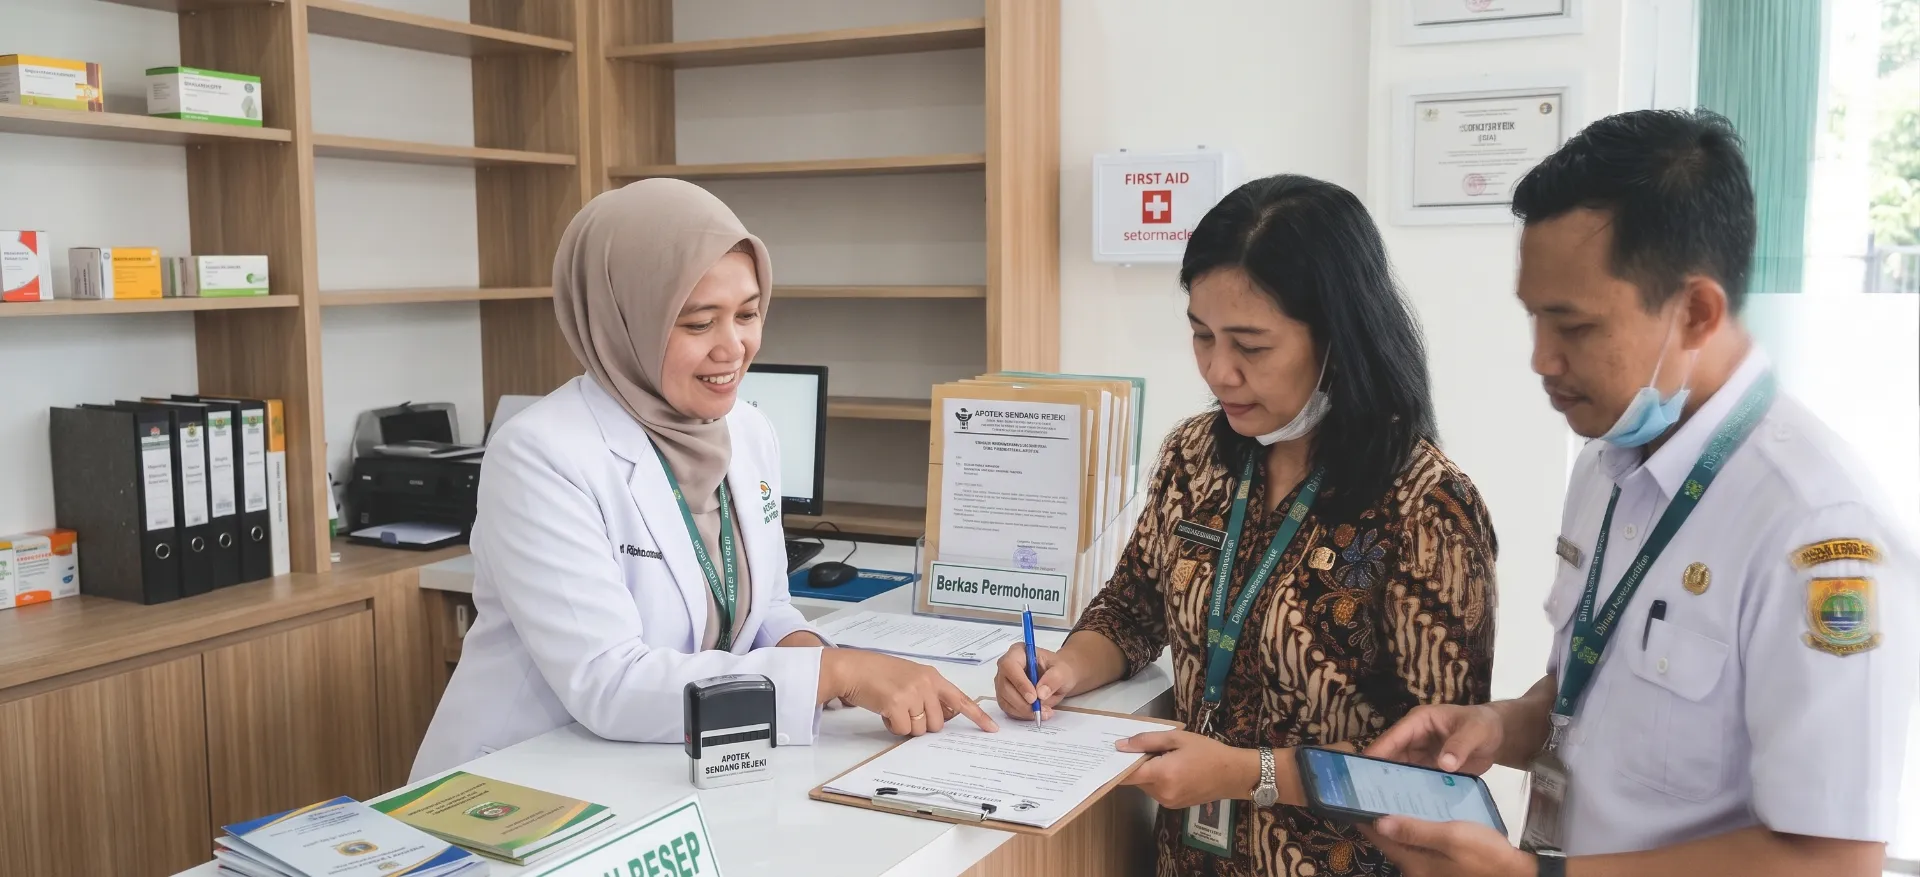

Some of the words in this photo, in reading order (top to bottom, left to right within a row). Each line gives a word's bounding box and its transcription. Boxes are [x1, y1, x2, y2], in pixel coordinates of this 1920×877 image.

[1125, 173, 1162, 185] FIRST
[1165, 172, 1190, 184] AID
[974, 410, 1004, 418] APOTEK
[1005, 412, 1040, 420] SENDANG
[1041, 413, 1066, 421] REJEKI
[936, 575, 978, 594] Berkas
[981, 579, 1060, 602] Permohonan
[721, 752, 750, 763] APOTEK
[705, 763, 740, 774] SENDANG
[741, 759, 767, 770] REJEKI
